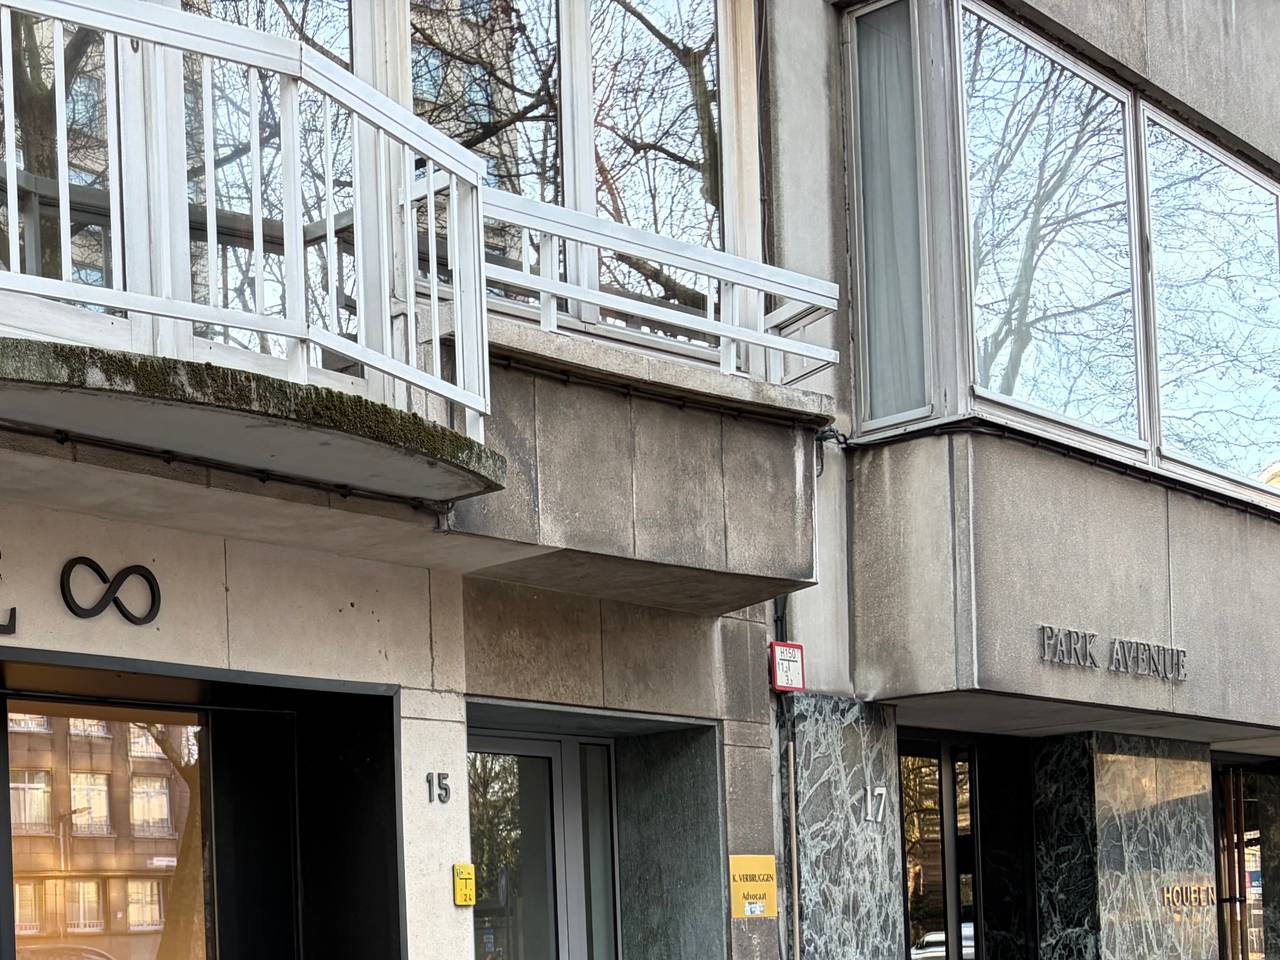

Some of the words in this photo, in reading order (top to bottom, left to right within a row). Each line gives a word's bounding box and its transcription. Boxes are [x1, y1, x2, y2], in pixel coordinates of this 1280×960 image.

[1039, 625, 1100, 670] PARK
[1108, 638, 1188, 682] AVENUE
[426, 772, 451, 804] 15
[864, 785, 887, 822] 17
[1162, 886, 1217, 907] HOUBEN
